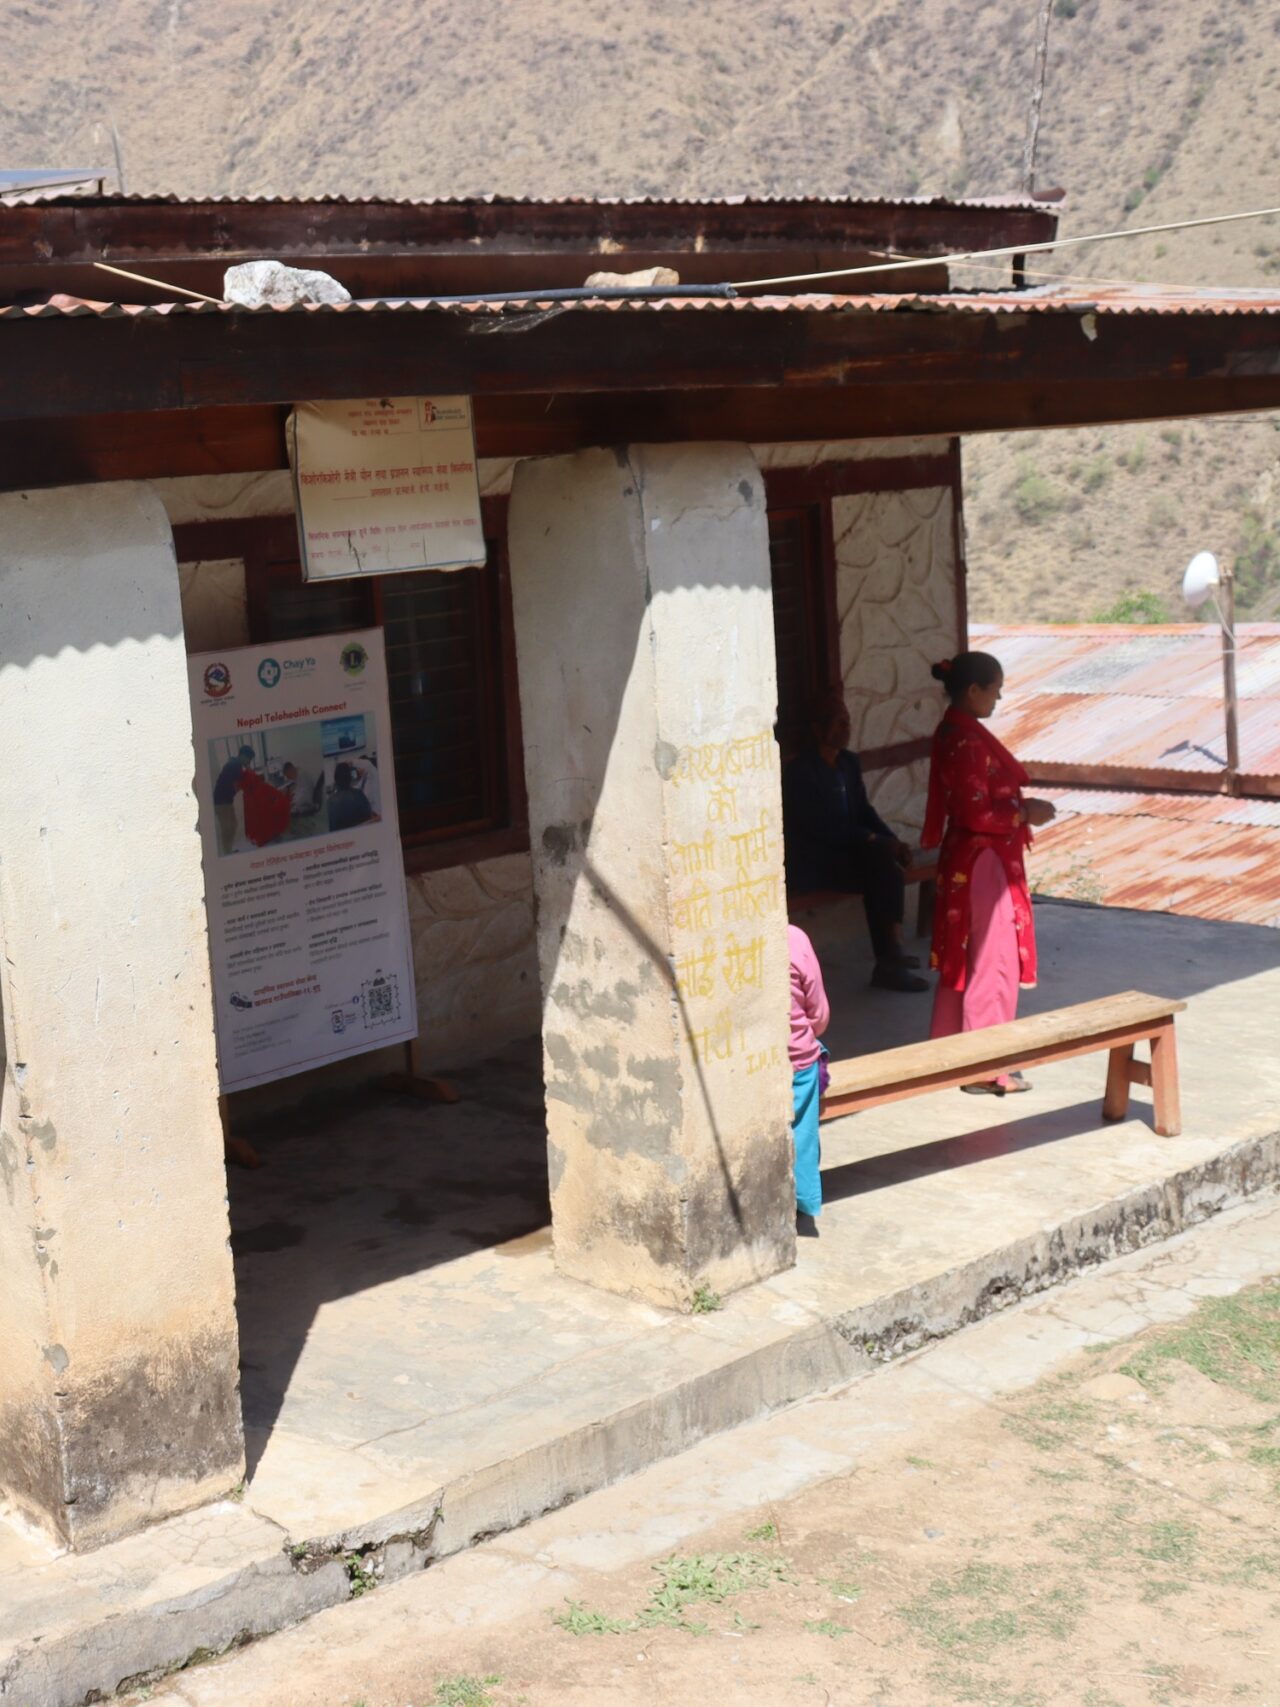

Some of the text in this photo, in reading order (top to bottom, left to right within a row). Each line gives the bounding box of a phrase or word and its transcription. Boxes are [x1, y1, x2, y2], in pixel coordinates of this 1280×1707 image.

[236, 702, 347, 729] Nepal Telehealth Connect
